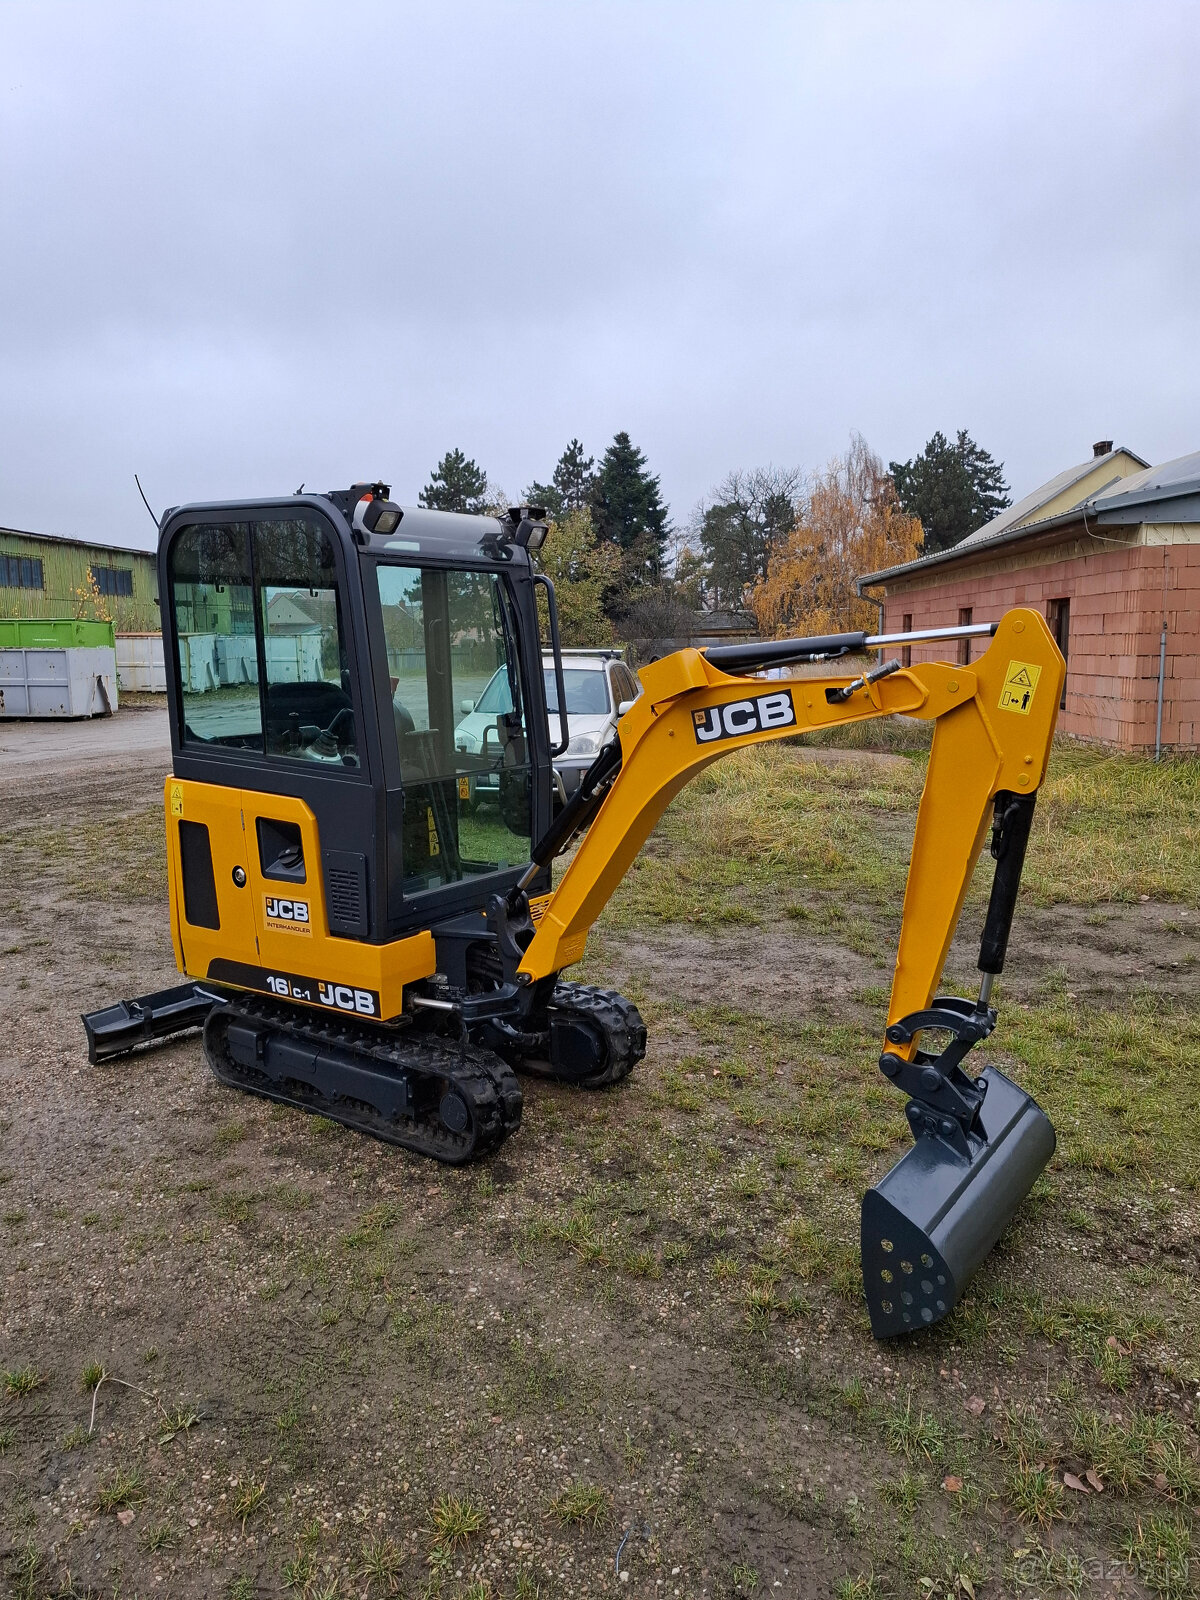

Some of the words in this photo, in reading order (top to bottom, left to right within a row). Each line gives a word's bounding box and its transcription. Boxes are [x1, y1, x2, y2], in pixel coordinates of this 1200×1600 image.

[696, 693, 794, 741] JCB
[267, 899, 309, 922] JCB
[266, 922, 311, 934] INTERHANDLER
[319, 983, 375, 1015] JCB
